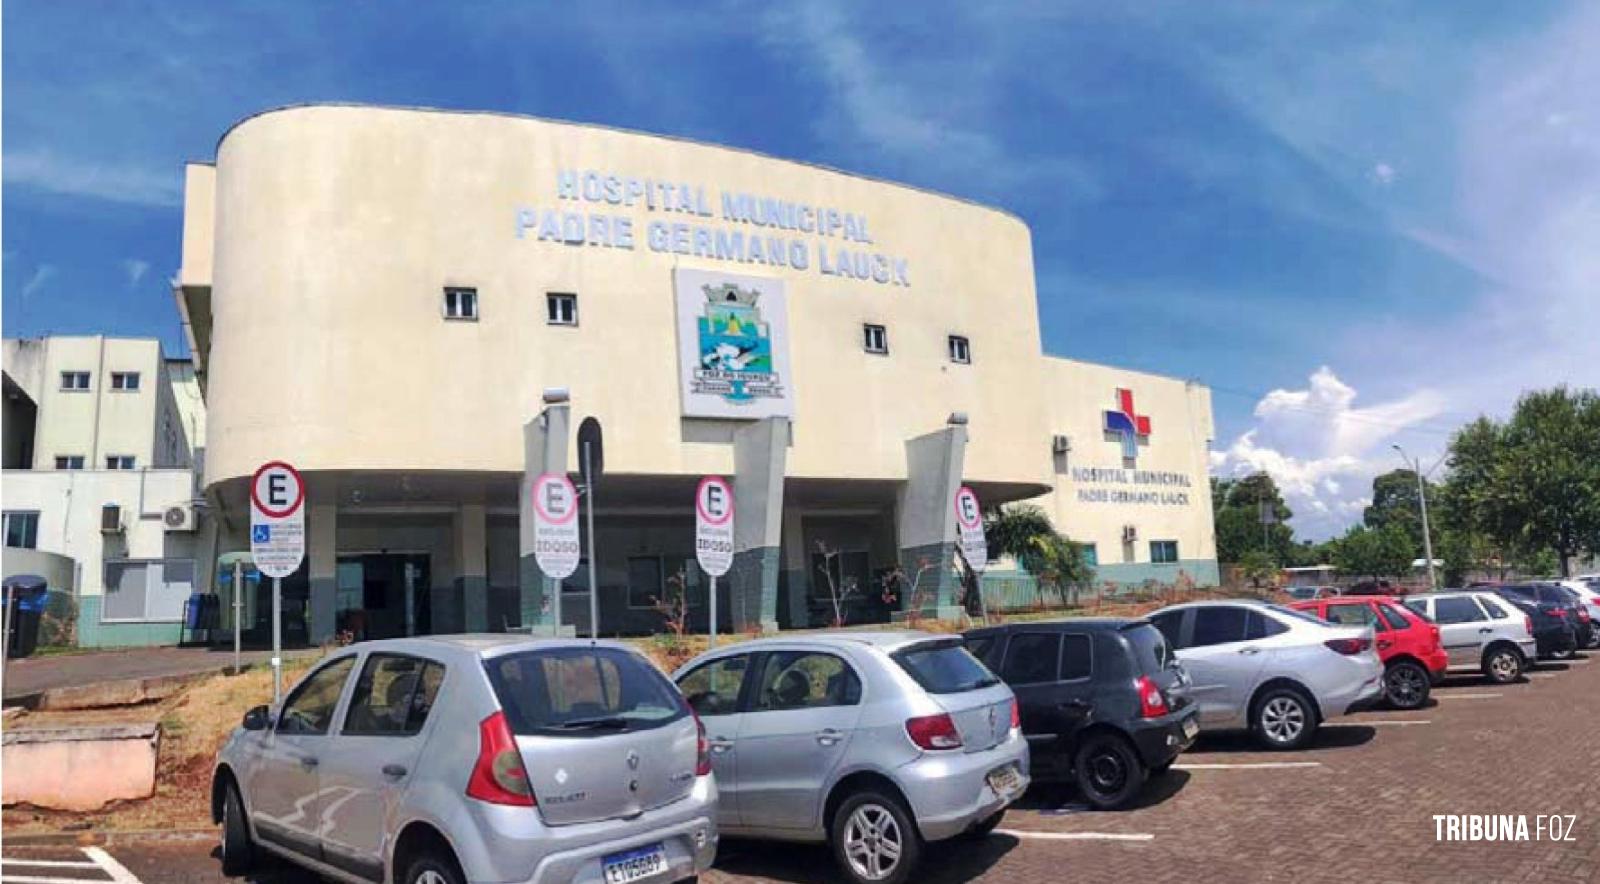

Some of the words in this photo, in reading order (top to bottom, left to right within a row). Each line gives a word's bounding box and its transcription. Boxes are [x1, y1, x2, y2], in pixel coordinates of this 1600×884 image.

[557, 168, 713, 217] HOSPITAL
[721, 189, 873, 244] MUNICIPAL
[515, 205, 635, 250] PADRE
[647, 219, 809, 271] GERMANO
[818, 243, 911, 287] LAUCK
[269, 474, 287, 505] E
[1072, 467, 1127, 483] HOSPITAL
[1134, 470, 1191, 487] MUNICIPAL
[546, 483, 565, 514] E
[708, 485, 722, 516] E
[961, 495, 975, 520] E
[1078, 489, 1108, 501] PADRE
[1111, 491, 1158, 505] GERMANO
[536, 540, 578, 554] IDOSO
